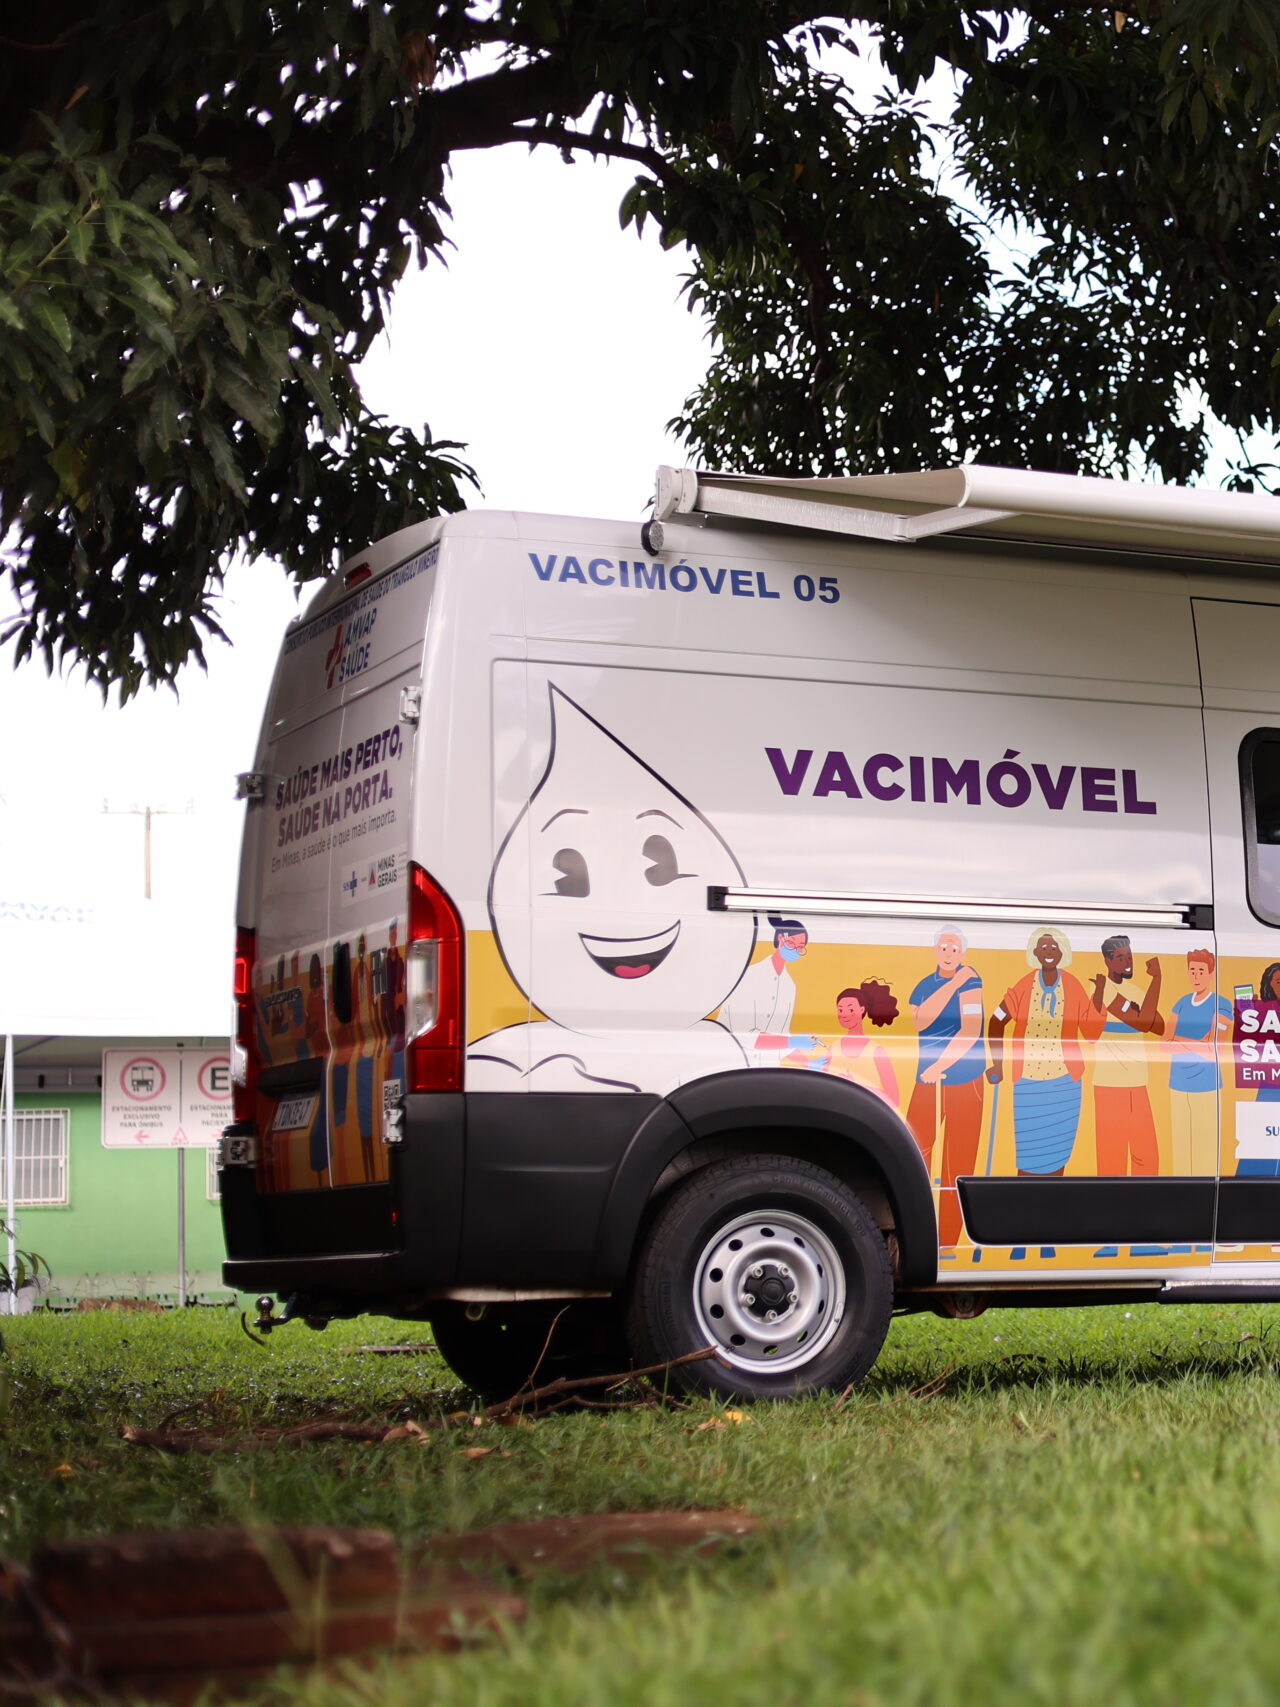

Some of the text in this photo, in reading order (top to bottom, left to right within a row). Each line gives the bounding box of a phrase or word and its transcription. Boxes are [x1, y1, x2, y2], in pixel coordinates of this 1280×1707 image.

[528, 553, 841, 604] VACIMÓVEL 05
[344, 608, 377, 645] AMVAP
[339, 642, 371, 682] SAÚDE
[276, 725, 403, 811] SAÚDE MAIS PERTO,
[764, 747, 1157, 815] VACIMÓVEL
[278, 769, 393, 848] SAÚDE NA PORTA.
[271, 857, 281, 873] Em
[339, 829, 350, 848] que
[351, 821, 367, 840] mais
[368, 809, 397, 833] importa.
[377, 854, 395, 872] MINAS
[377, 869, 398, 888] GERAIS
[210, 1067, 230, 1091] E
[1242, 1067, 1266, 1081] Em
